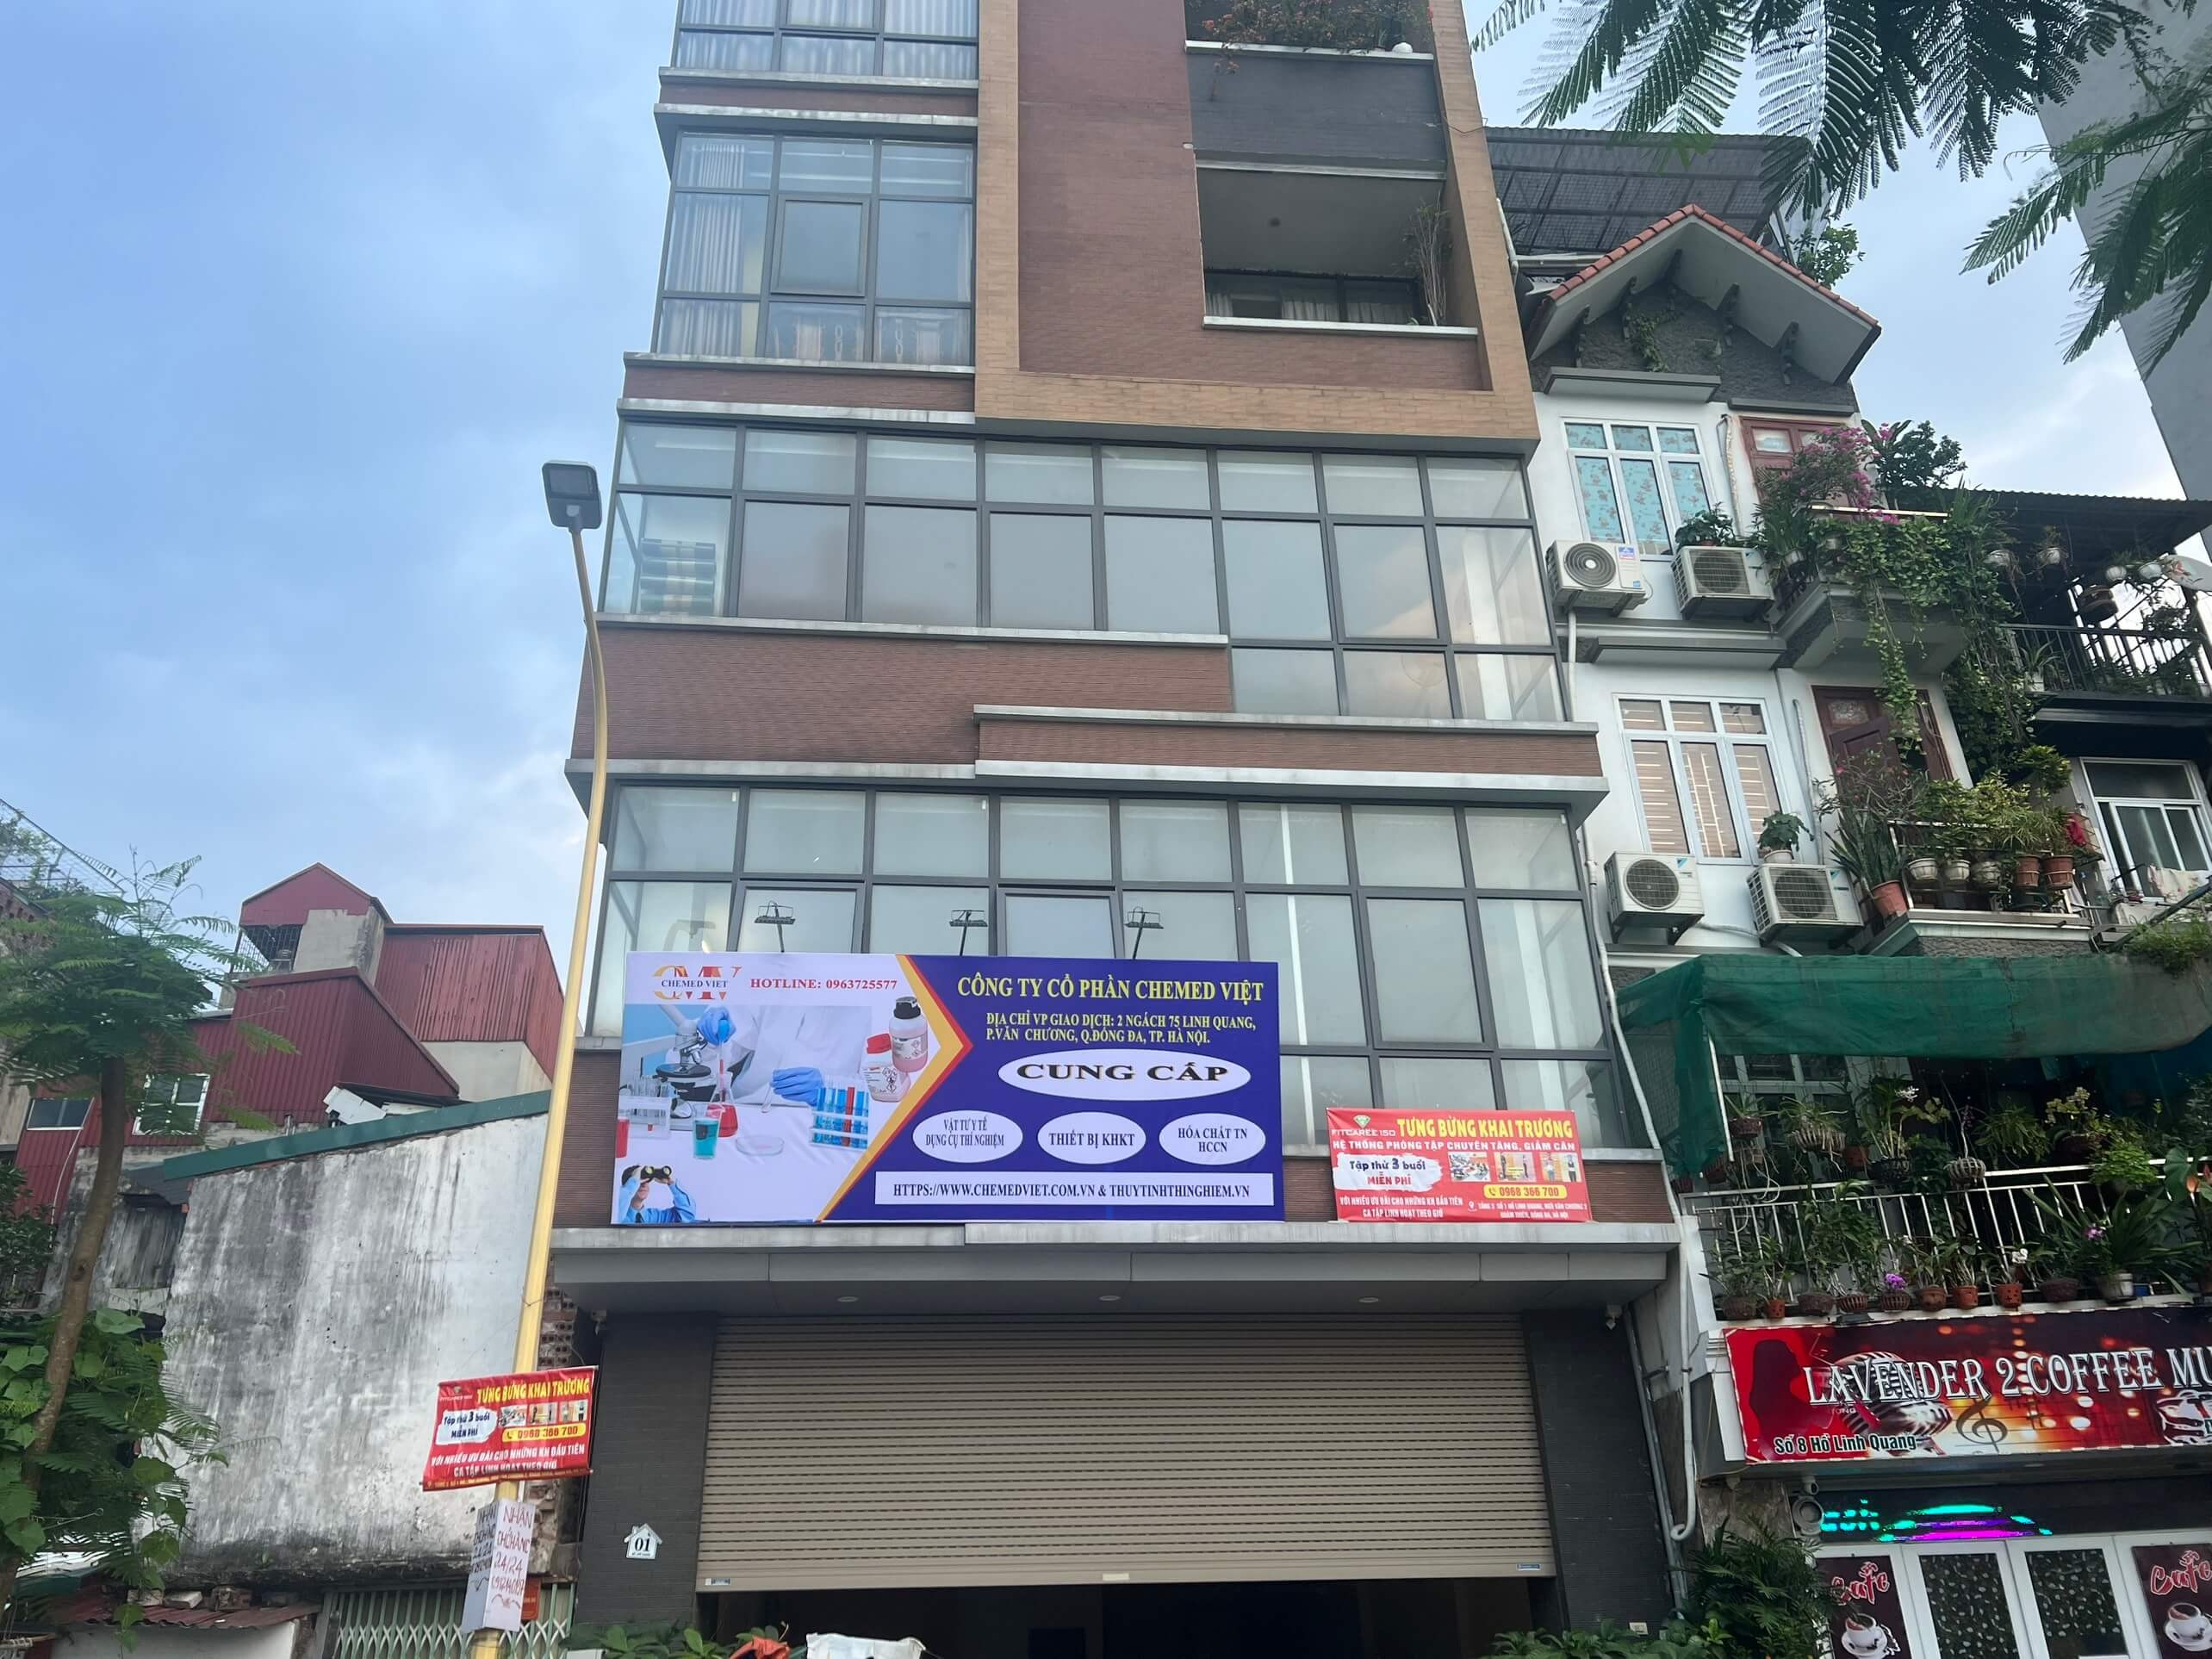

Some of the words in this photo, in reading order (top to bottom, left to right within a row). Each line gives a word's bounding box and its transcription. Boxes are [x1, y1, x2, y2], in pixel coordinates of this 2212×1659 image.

[662, 979, 704, 989] CHEMED
[705, 979, 729, 989] VIET
[750, 979, 821, 989] HOTLINE:
[826, 979, 898, 990] 0963725577
[957, 972, 1013, 997] CÔNG
[1018, 978, 1043, 997] TY
[1047, 973, 1074, 997] CỔ
[1078, 974, 1130, 999] PHẦN
[1135, 980, 1215, 1001] CHEMED
[1220, 979, 1264, 1005] VIỆT
[986, 1012, 1007, 1027] ĐỊA
[1010, 1010, 1031, 1025] CHỈ
[1033, 1013, 1047, 1025] VP
[1050, 1013, 1079, 1026] GIAO
[1082, 1014, 1115, 1029] DỊCH:
[1117, 1015, 1123, 1027] 2
[1126, 1011, 1165, 1027] NGÁCH
[1169, 1016, 1180, 1028] 75
[1183, 1016, 1210, 1028] LINH
[1213, 1016, 1257, 1031] QUANG,
[1024, 1027, 1078, 1043] CHƯƠNG,
[1128, 1030, 1147, 1044] ĐA,
[1149, 1030, 1165, 1043] TP.
[1167, 1028, 1184, 1043] HÀ
[1186, 1029, 1210, 1046] NỘI.
[1016, 1064, 1136, 1081] CUNG
[1147, 1061, 1228, 1082] CẤP
[943, 1117, 959, 1134] VẬT
[971, 1119, 977, 1131] Y
[1177, 1125, 1201, 1139] HÓA
[1202, 1125, 1231, 1139] CHẤT
[1233, 1128, 1248, 1140] TN
[1396, 1117, 1436, 1138] TƯNG
[1438, 1116, 1477, 1139] BỪNG
[1478, 1119, 1514, 1139] KHAI
[1515, 1118, 1574, 1139] TRƯƠNG
[926, 1134, 947, 1149] DỤNG
[948, 1134, 959, 1149] CỤ
[974, 1134, 1004, 1149] NGHIỆM
[1048, 1129, 1084, 1146] THIẾT
[1087, 1134, 1099, 1148] BỊ
[1102, 1134, 1135, 1146] KHKT
[1333, 1139, 1346, 1152] HỆ
[1424, 1140, 1445, 1152] TẬP
[1447, 1140, 1489, 1151] CHUYÊN
[1198, 1141, 1227, 1153] HCCN
[1350, 1160, 1369, 1171] Tập
[1391, 1158, 1400, 1171] 3
[1368, 1171, 1392, 1185] MIỄN
[1395, 1173, 1412, 1185] PHÍ
[893, 1183, 1095, 1199] HTTPS://WWW.CHEMEDVIET.COM.VN
[1098, 1184, 1107, 1196] &
[1109, 1184, 1250, 1198] THUYTINHTHINGHIEM.VN
[1542, 1187, 1559, 1197] 700
[1803, 1357, 1991, 1406] LAVENDER
[2025, 1348, 2164, 1397] COFFEE
[527, 1381, 551, 1398] KHAI
[469, 1411, 474, 1422] 3
[1774, 1434, 1794, 1453] Số
[1797, 1437, 1807, 1453] 8
[1810, 1433, 1830, 1452] Hồ
[1833, 1434, 1866, 1452] Linh
[1868, 1433, 1917, 1451] Quang
[503, 1506, 533, 1529] NHẬN
[635, 1538, 650, 1551] 01
